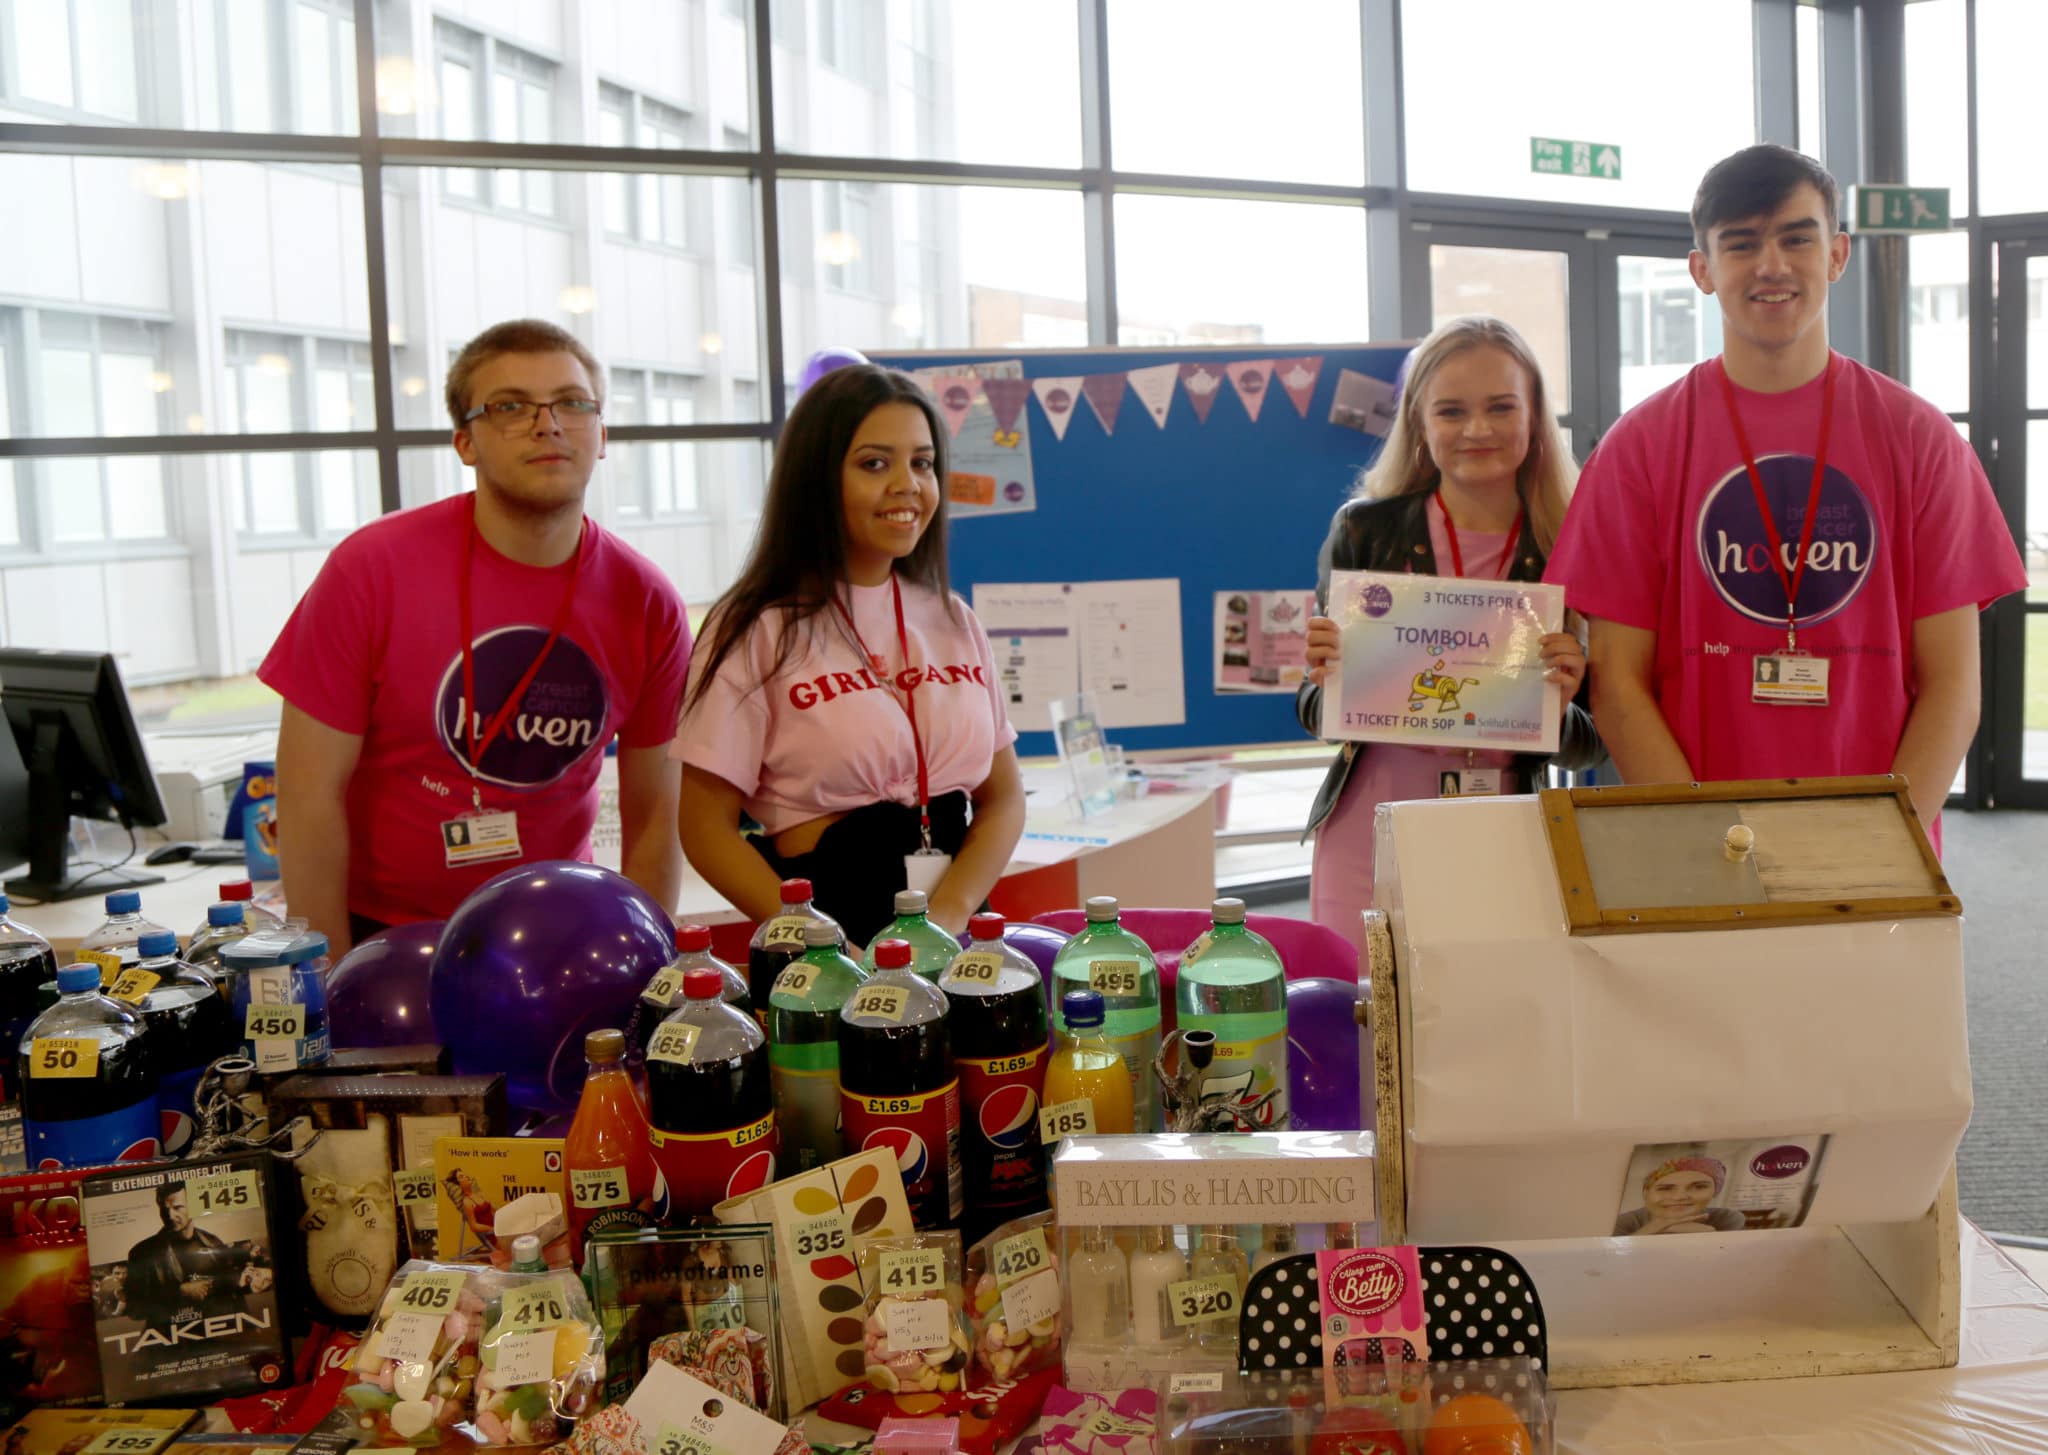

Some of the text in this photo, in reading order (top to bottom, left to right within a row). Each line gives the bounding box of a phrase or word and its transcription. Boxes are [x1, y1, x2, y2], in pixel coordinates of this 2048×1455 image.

[1536, 140, 1563, 156] Fire
[1537, 158, 1562, 171] exit
[1786, 503, 1849, 521] brast
[1786, 521, 1857, 537] cncer
[1424, 592, 1431, 603] 3
[1435, 592, 1485, 607] TICKETS
[1488, 596, 1513, 609] FOR
[1394, 626, 1490, 648] TOMBOLA
[1704, 641, 1729, 657] help
[789, 669, 881, 710] GIRL
[1345, 712, 1455, 730] 1 TICKET FOR 50P
[421, 775, 449, 797] help
[769, 926, 805, 941] 470
[952, 964, 993, 980] 460
[1093, 973, 1136, 990] 495
[853, 997, 897, 1014] 485
[250, 1018, 297, 1035] 450
[43, 1050, 78, 1069] 50
[988, 1057, 1026, 1074] £1.69
[868, 1099, 910, 1113] £1.69
[736, 1120, 770, 1145] £1.69
[1047, 1113, 1087, 1135] 185
[112, 1163, 232, 1192] EXTENDED HARDER CUT
[199, 1186, 248, 1209] 145
[575, 1181, 620, 1201] 375
[1077, 1176, 1356, 1207] BAYLIS & HARDING
[798, 1229, 845, 1255] 335
[998, 1247, 1041, 1276] 420
[1339, 1262, 1386, 1279] Along came
[631, 1262, 765, 1283] photoframe
[887, 1265, 938, 1287] 415
[1339, 1271, 1396, 1303] Betty
[402, 1286, 451, 1308] 405
[1182, 1290, 1233, 1318] 320
[514, 1300, 563, 1324] 410
[103, 1307, 271, 1354] TAKEN
[691, 1416, 714, 1432] M&S
[104, 1436, 155, 1449] 195
[660, 1439, 711, 1455] 30
